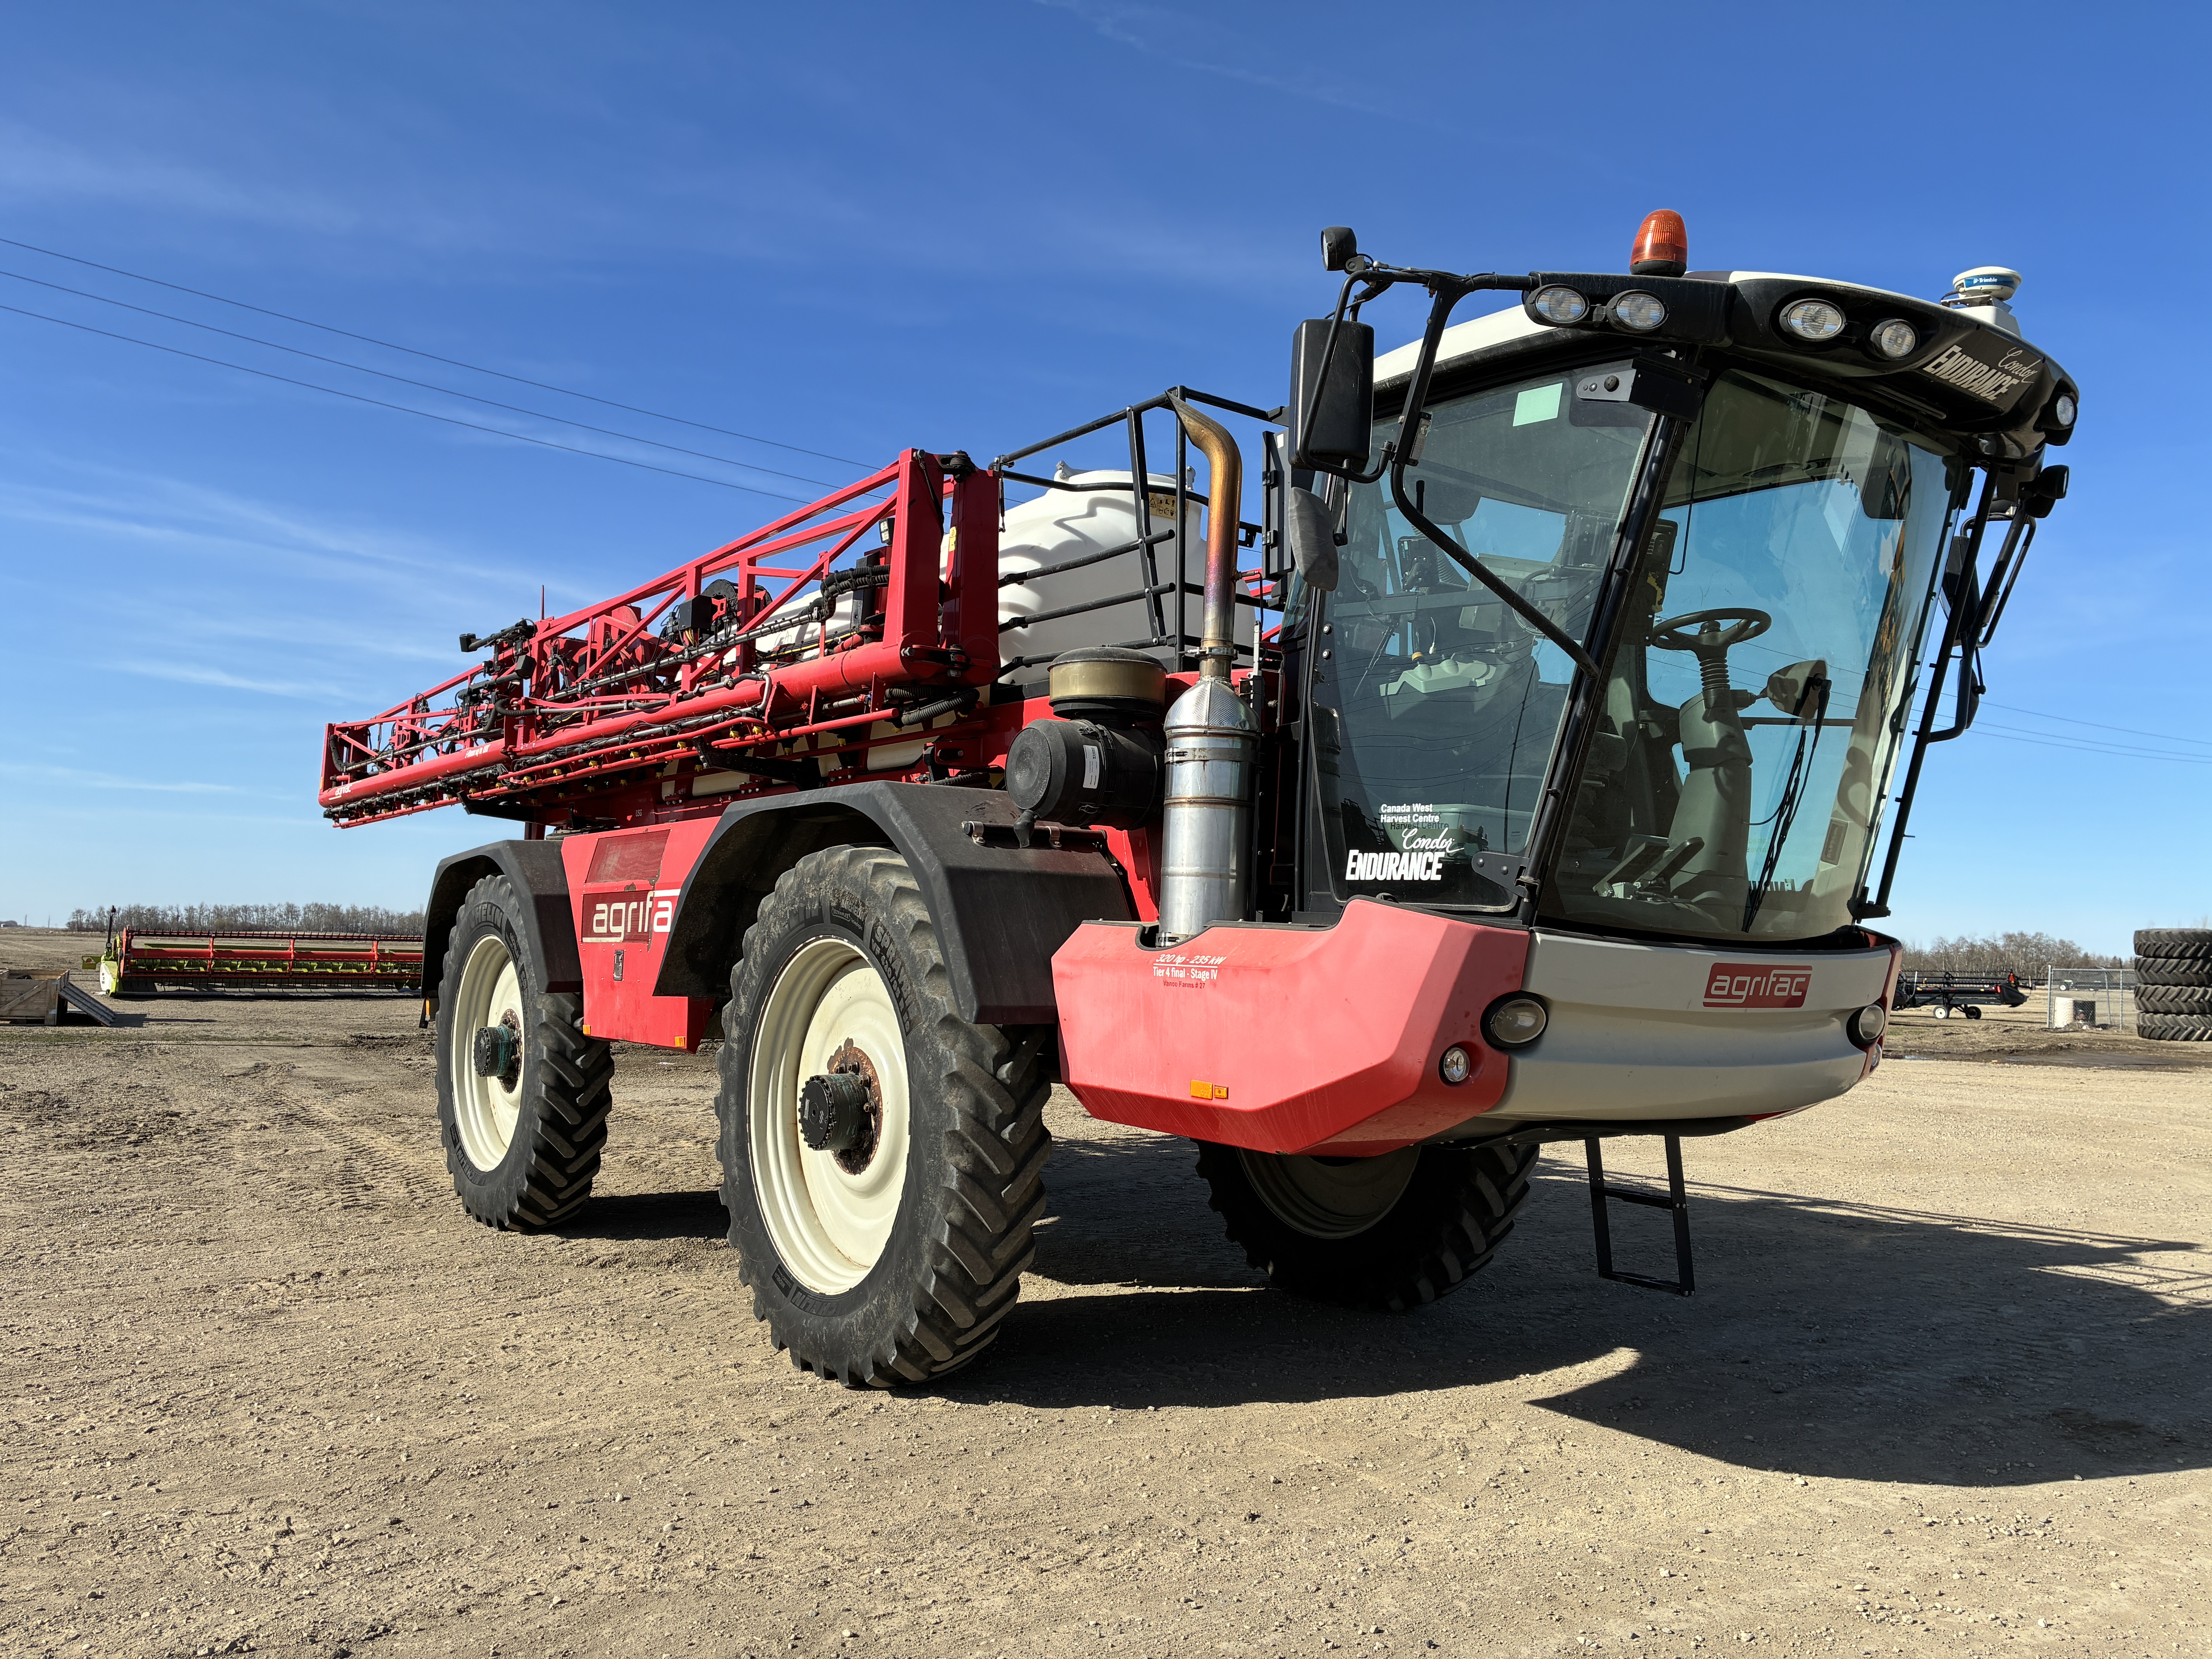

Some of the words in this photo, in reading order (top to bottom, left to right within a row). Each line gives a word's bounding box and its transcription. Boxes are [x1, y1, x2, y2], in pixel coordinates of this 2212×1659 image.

[1923, 345, 2020, 400] ENDURANCE
[1998, 347, 2041, 383] Condor
[1381, 804, 1410, 812] Canada
[1412, 803, 1432, 812] West
[1381, 814, 1411, 823] Harvest
[1412, 814, 1439, 822] Centre
[1402, 828, 1464, 853] Condor
[1346, 849, 1445, 880] ENDURANCE
[588, 890, 677, 942] agrifa
[875, 926, 917, 1019] SPRAYBIB
[1153, 966, 1164, 977] Tier
[1165, 967, 1170, 977] 4
[1171, 967, 1185, 978] final
[1190, 968, 1209, 981] Stage
[1211, 969, 1218, 980] IV
[1156, 954, 1176, 962] 320
[1173, 955, 1186, 965] hp
[1189, 955, 1211, 964] 235
[1208, 956, 1227, 965] kW
[1705, 970, 1811, 1003] agrifac
